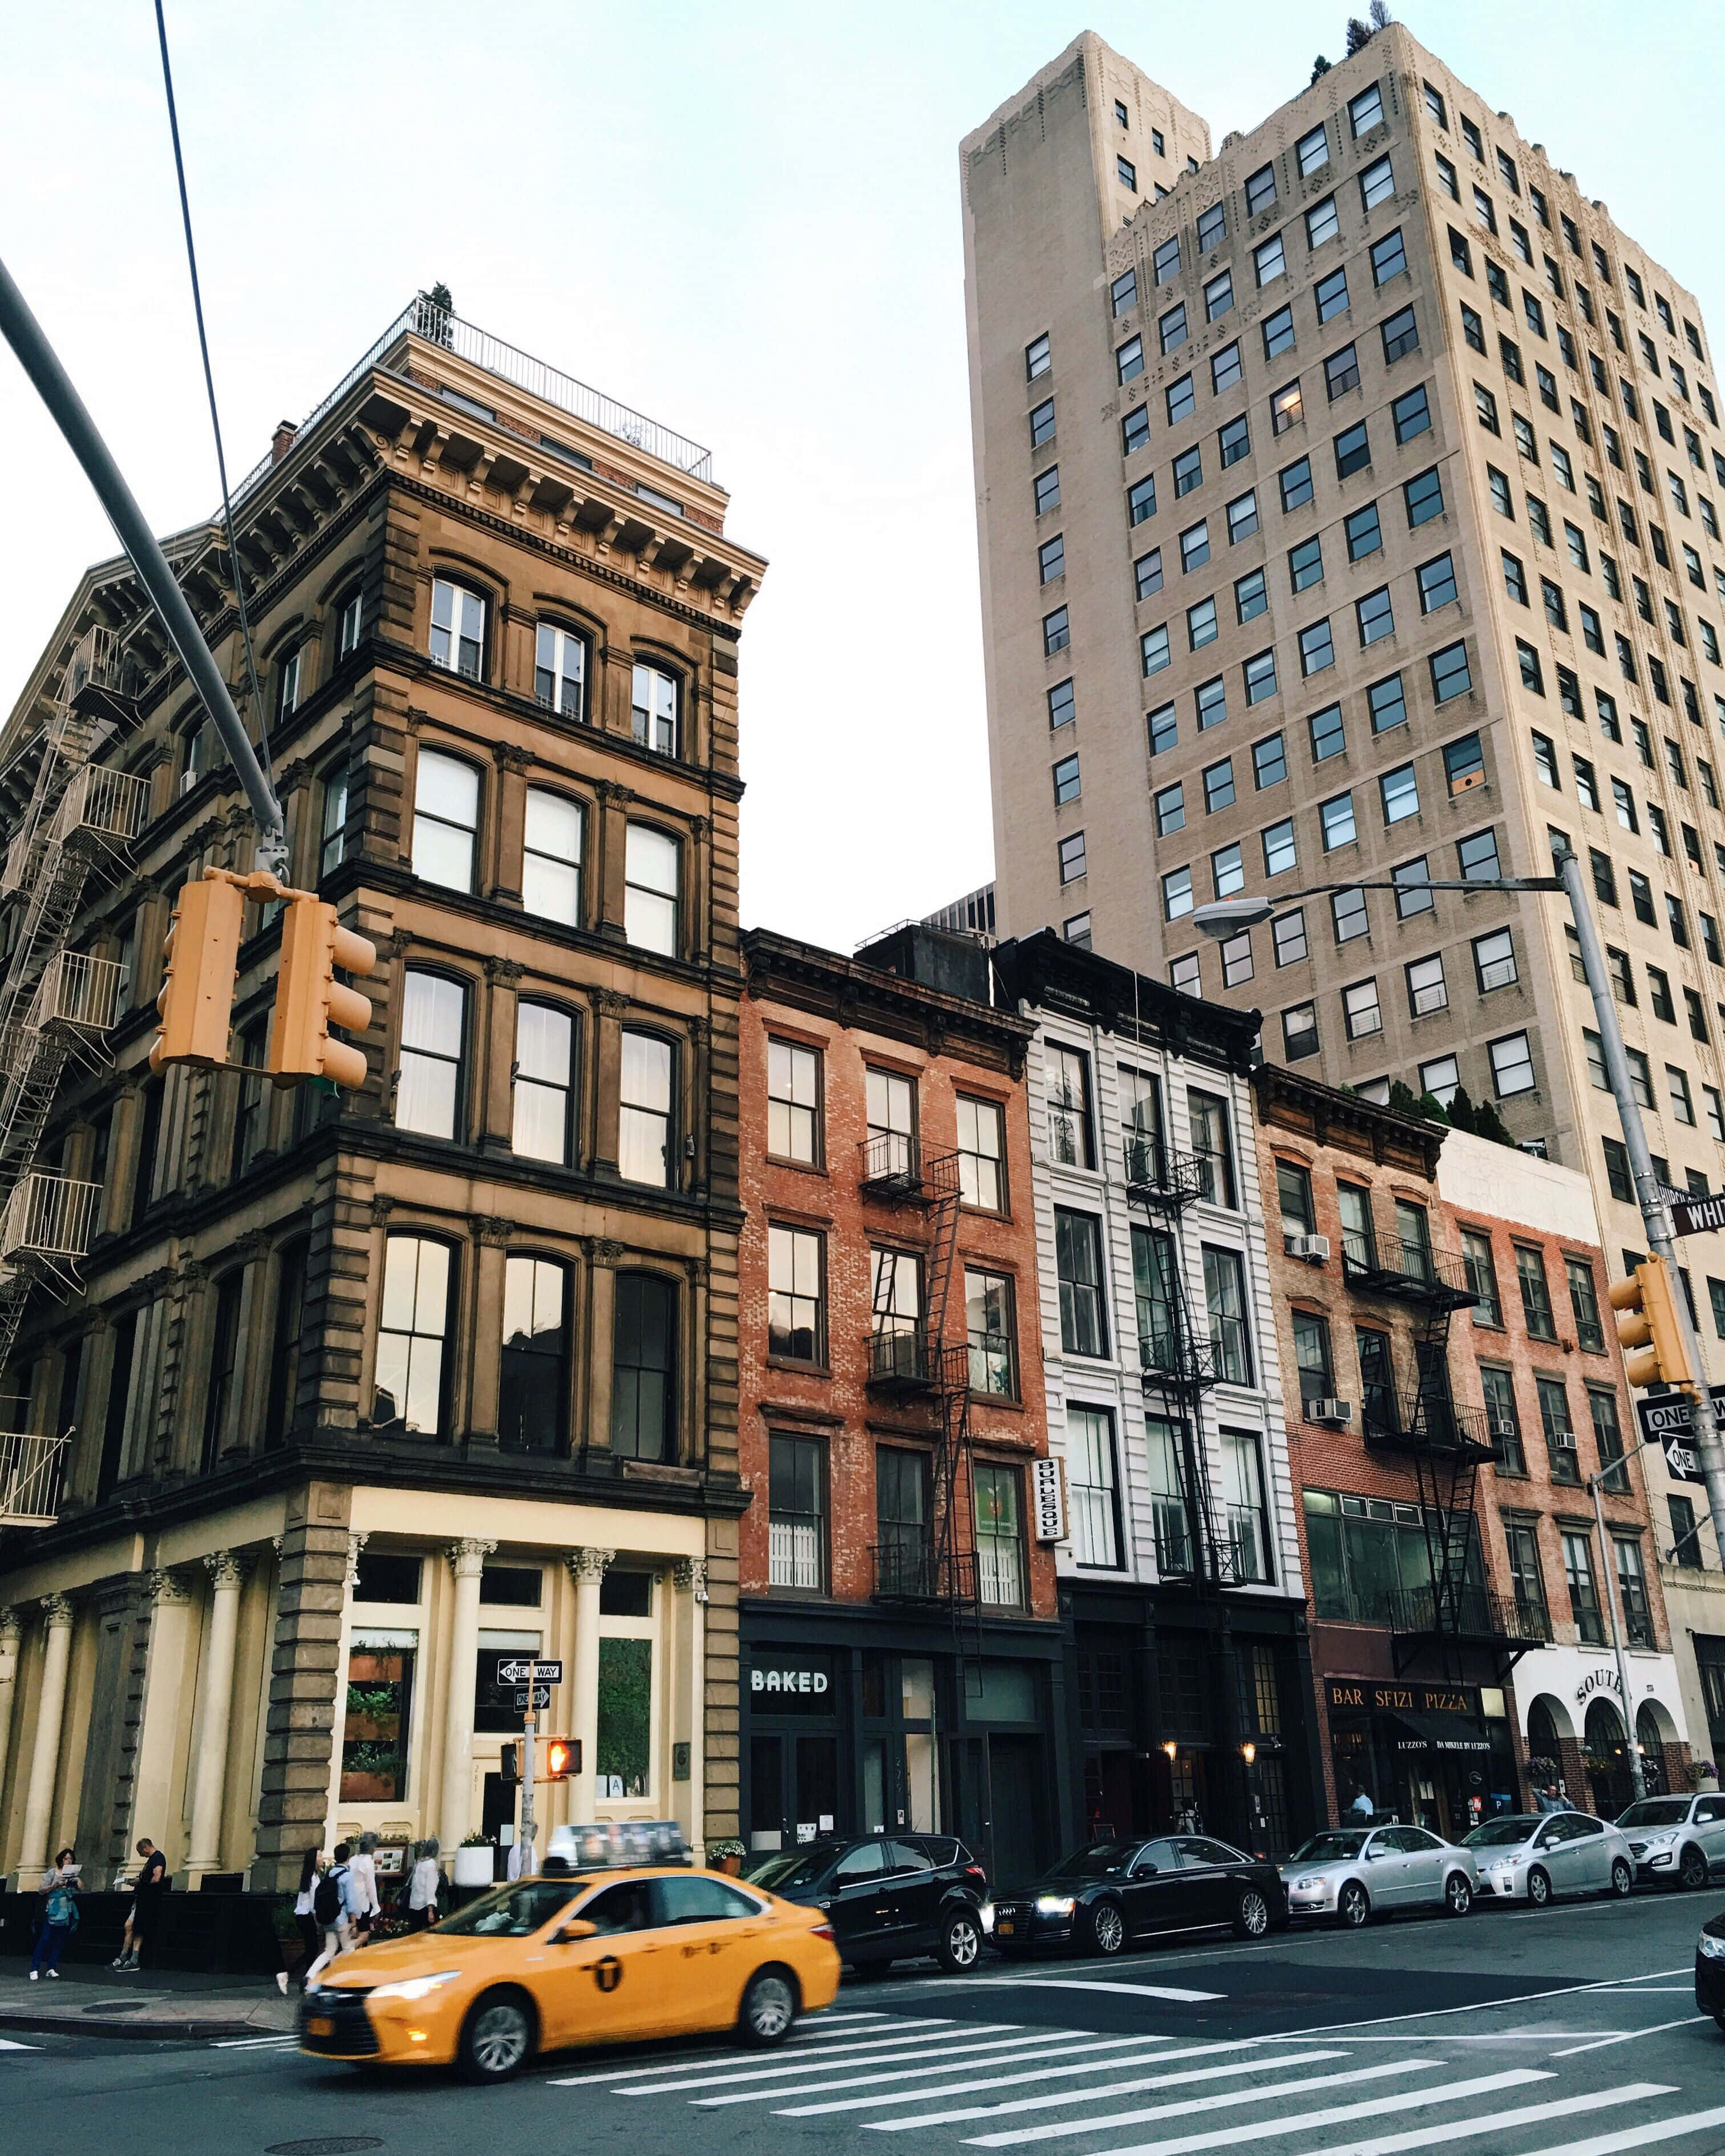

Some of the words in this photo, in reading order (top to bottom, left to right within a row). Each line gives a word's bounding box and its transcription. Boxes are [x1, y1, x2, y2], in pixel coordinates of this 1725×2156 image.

[1652, 1406, 1691, 1428] ONE
[1673, 1450, 1694, 1469] ONE
[1039, 1462, 1058, 1536] BURLESQUE
[505, 1667, 526, 1677] ONE
[537, 1667, 556, 1677] WAY
[752, 1670, 828, 1693] BAKED
[518, 1694, 529, 1703] ONE
[534, 1693, 546, 1702] WAY
[1333, 1688, 1364, 1705] BAR
[1375, 1690, 1414, 1708] SFIZI
[1426, 1693, 1468, 1711] PIZZA
[612, 1779, 620, 1790] A
[1496, 1801, 1501, 1810] P
